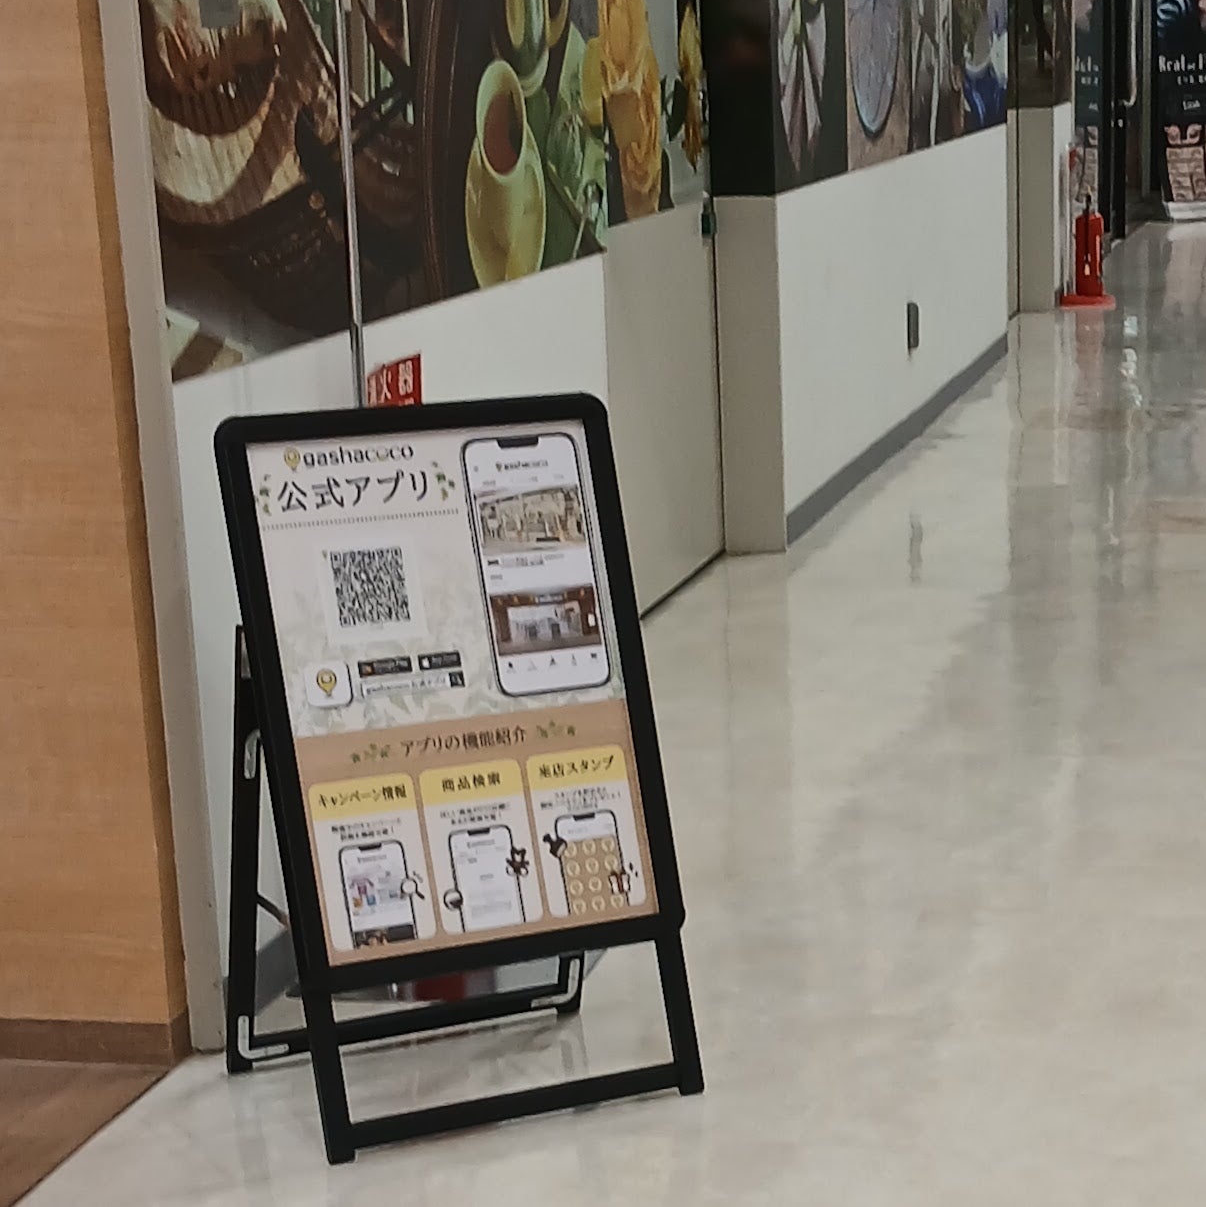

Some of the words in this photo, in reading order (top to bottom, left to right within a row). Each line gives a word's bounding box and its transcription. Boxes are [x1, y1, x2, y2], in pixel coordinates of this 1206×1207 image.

[303, 444, 415, 469] gashacoco
[277, 469, 428, 513] 公式アプリ
[400, 725, 526, 757] アプリの機能紹介
[442, 771, 501, 793] 商品検索
[318, 784, 408, 810] キャンペーン情報
